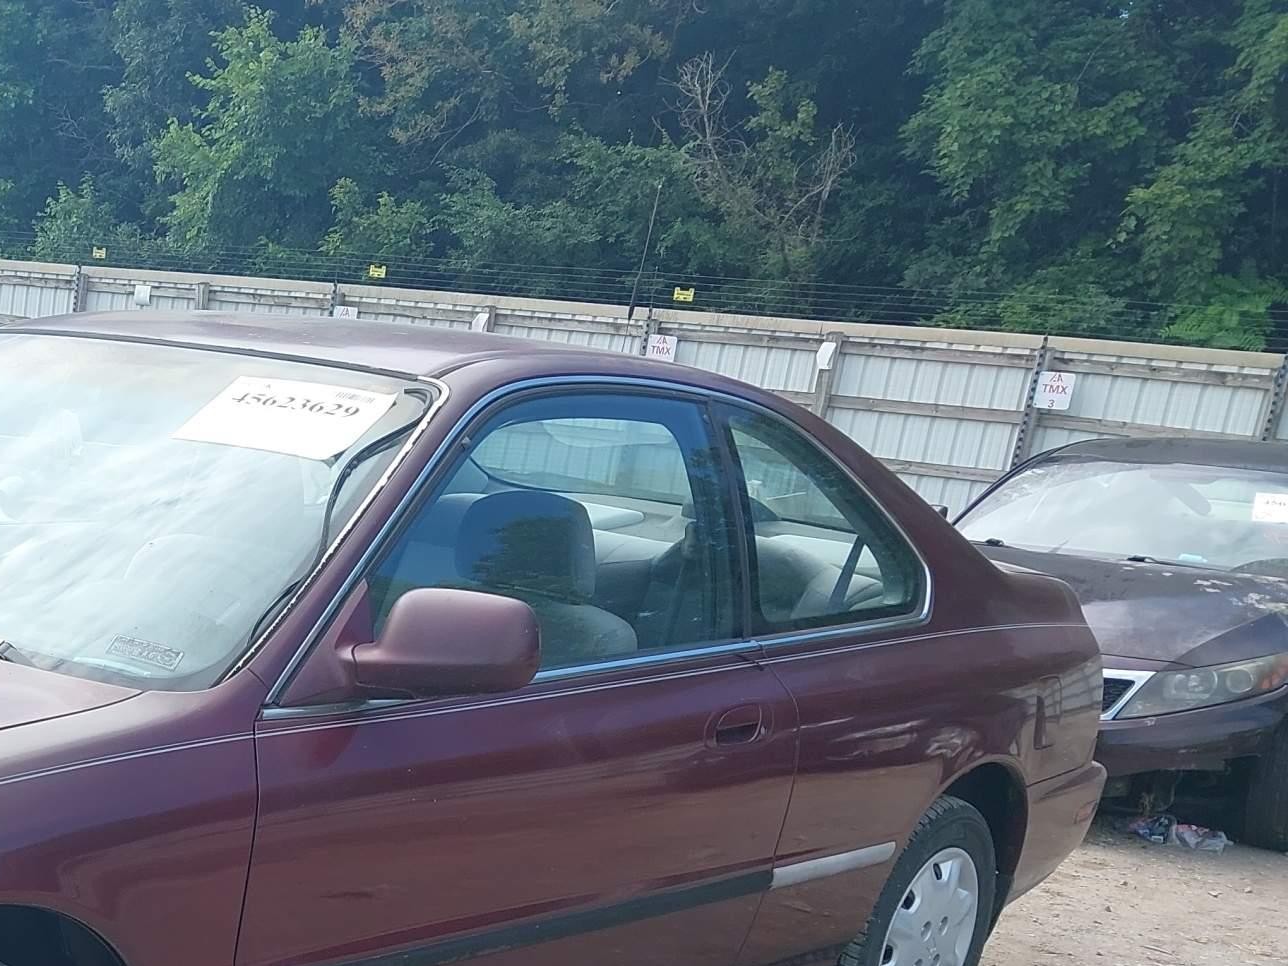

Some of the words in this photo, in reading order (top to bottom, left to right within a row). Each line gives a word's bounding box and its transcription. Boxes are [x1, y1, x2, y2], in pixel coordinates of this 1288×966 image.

[651, 345, 671, 356] TMX
[1042, 383, 1069, 395] TMX
[231, 391, 361, 418] 45623629
[1047, 399, 1056, 408] 3
